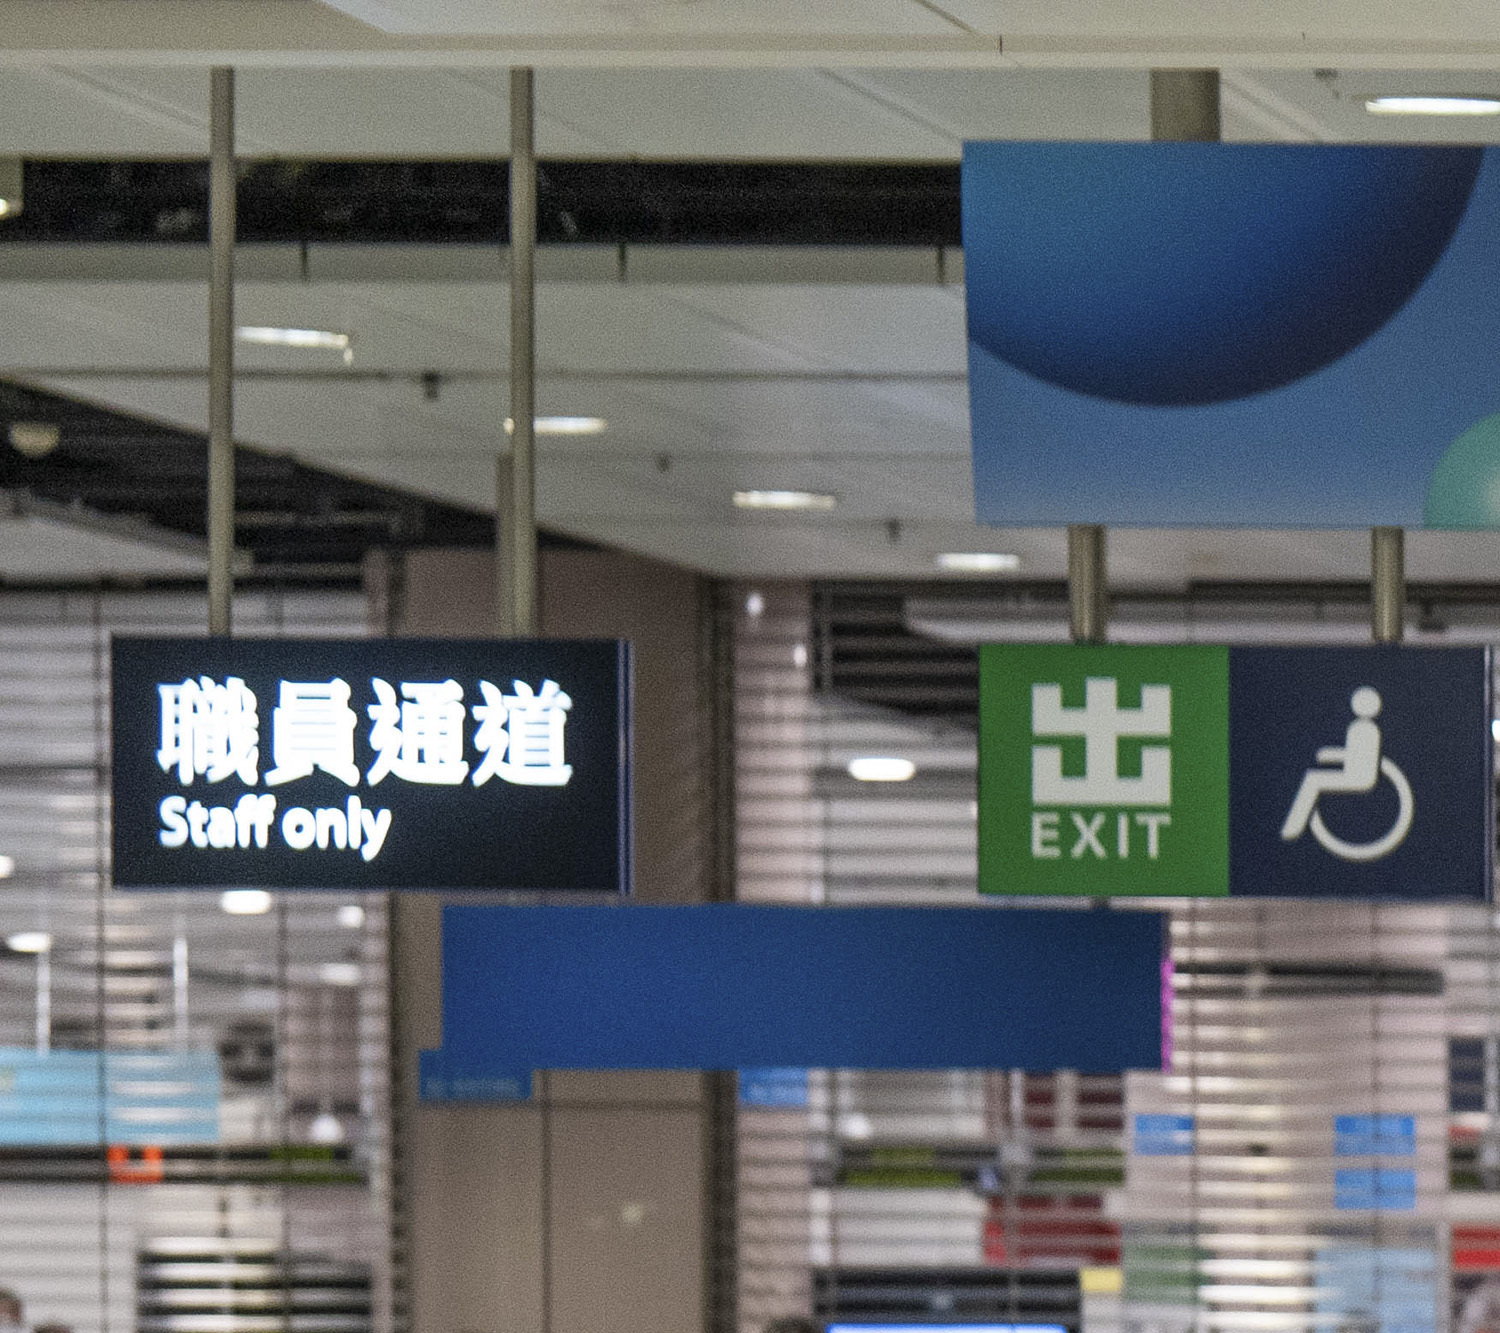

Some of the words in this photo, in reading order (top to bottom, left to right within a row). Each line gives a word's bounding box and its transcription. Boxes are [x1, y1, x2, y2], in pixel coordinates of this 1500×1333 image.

[156, 675, 573, 787] 職員通道
[1031, 676, 1172, 807] 出
[159, 793, 277, 849] Staff
[281, 794, 392, 862] only
[1031, 811, 1171, 860] EXIT
